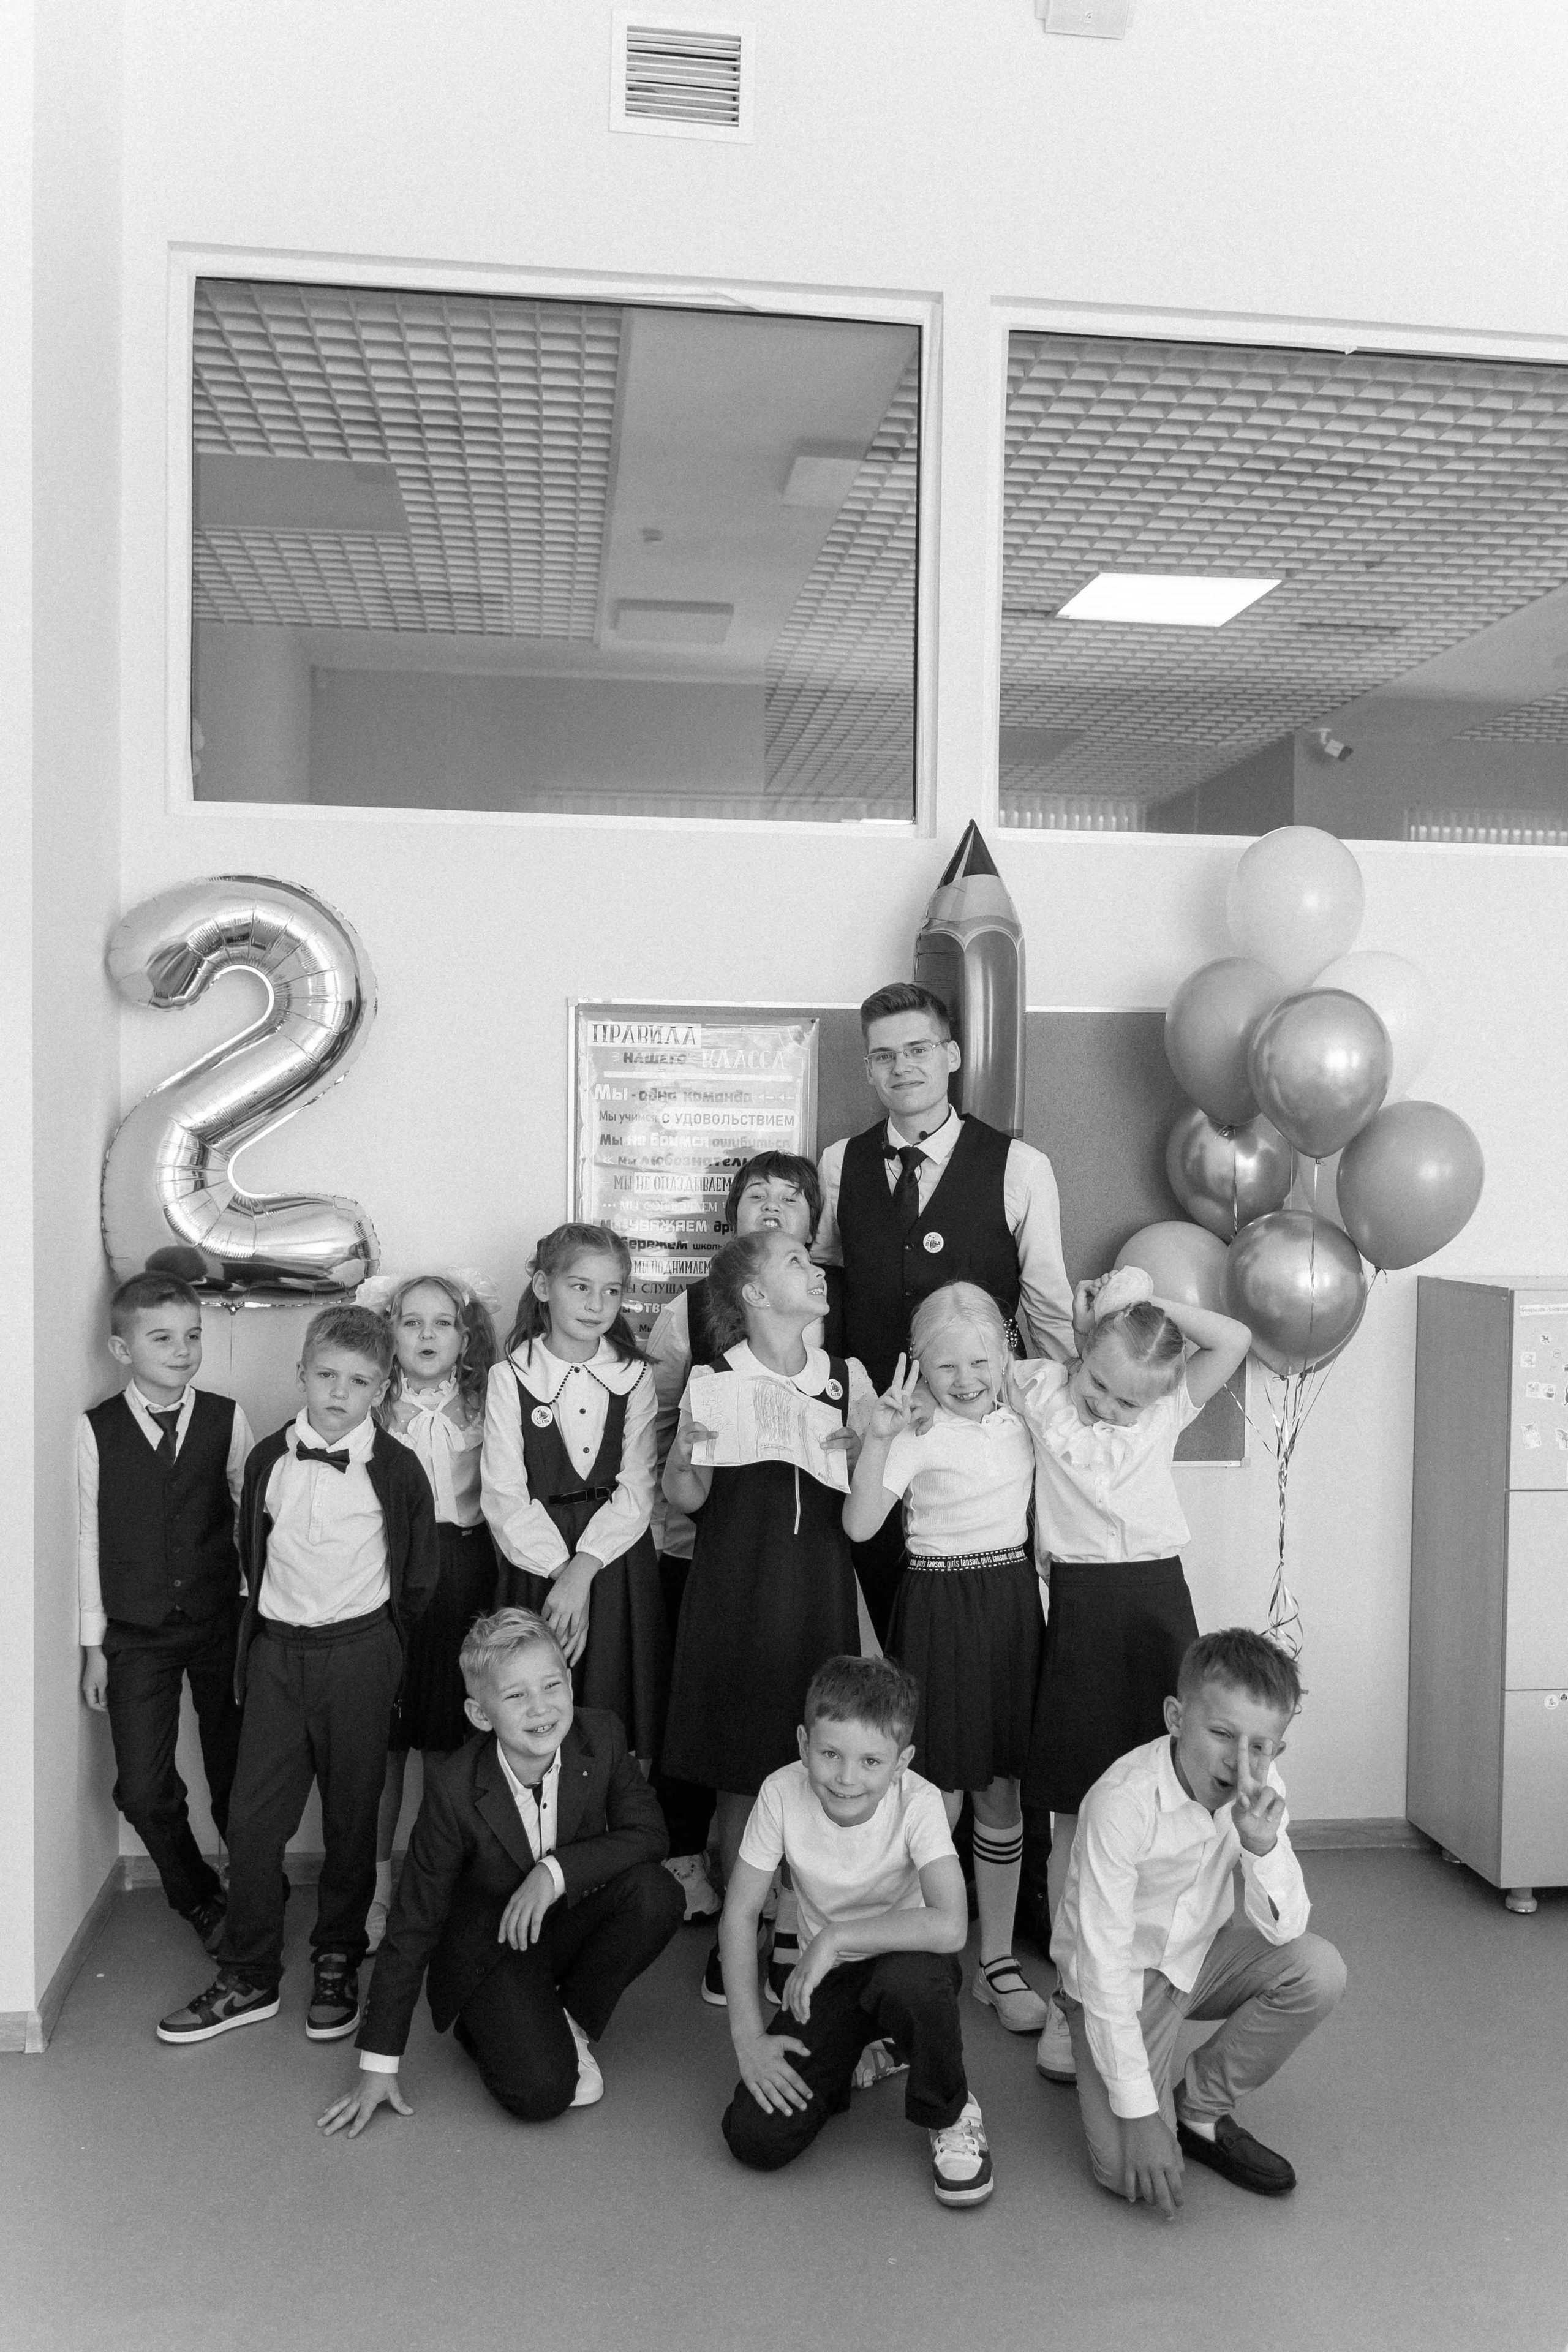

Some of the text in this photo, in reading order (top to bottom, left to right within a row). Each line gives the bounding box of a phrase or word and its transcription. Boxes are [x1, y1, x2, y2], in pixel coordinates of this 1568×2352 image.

[592, 1024, 696, 1045] ПРАВИЛА
[623, 1049, 786, 1069] НАШЕГО КЛАССА
[103, 875, 381, 1307] 2
[594, 1084, 628, 1101] Мы
[639, 1088, 677, 1102] одна
[684, 1089, 753, 1103] команда
[599, 1110, 617, 1121] Мы
[619, 1113, 657, 1125] учимся
[674, 1113, 794, 1126] УДОВОЛЬСТВИЕМ
[600, 1134, 623, 1145] Мы
[614, 1175, 733, 1193] МЫ НЕ ОПАЗДЫВАЕМ
[652, 1260, 711, 1275] ПОДНИМАЕМ
[641, 1283, 685, 1294] СЛУША
[927, 1559, 946, 1568] lanson.
[947, 1559, 960, 1569] girls
[960, 1558, 981, 1567] lanson.
[981, 1556, 992, 1565] girls
